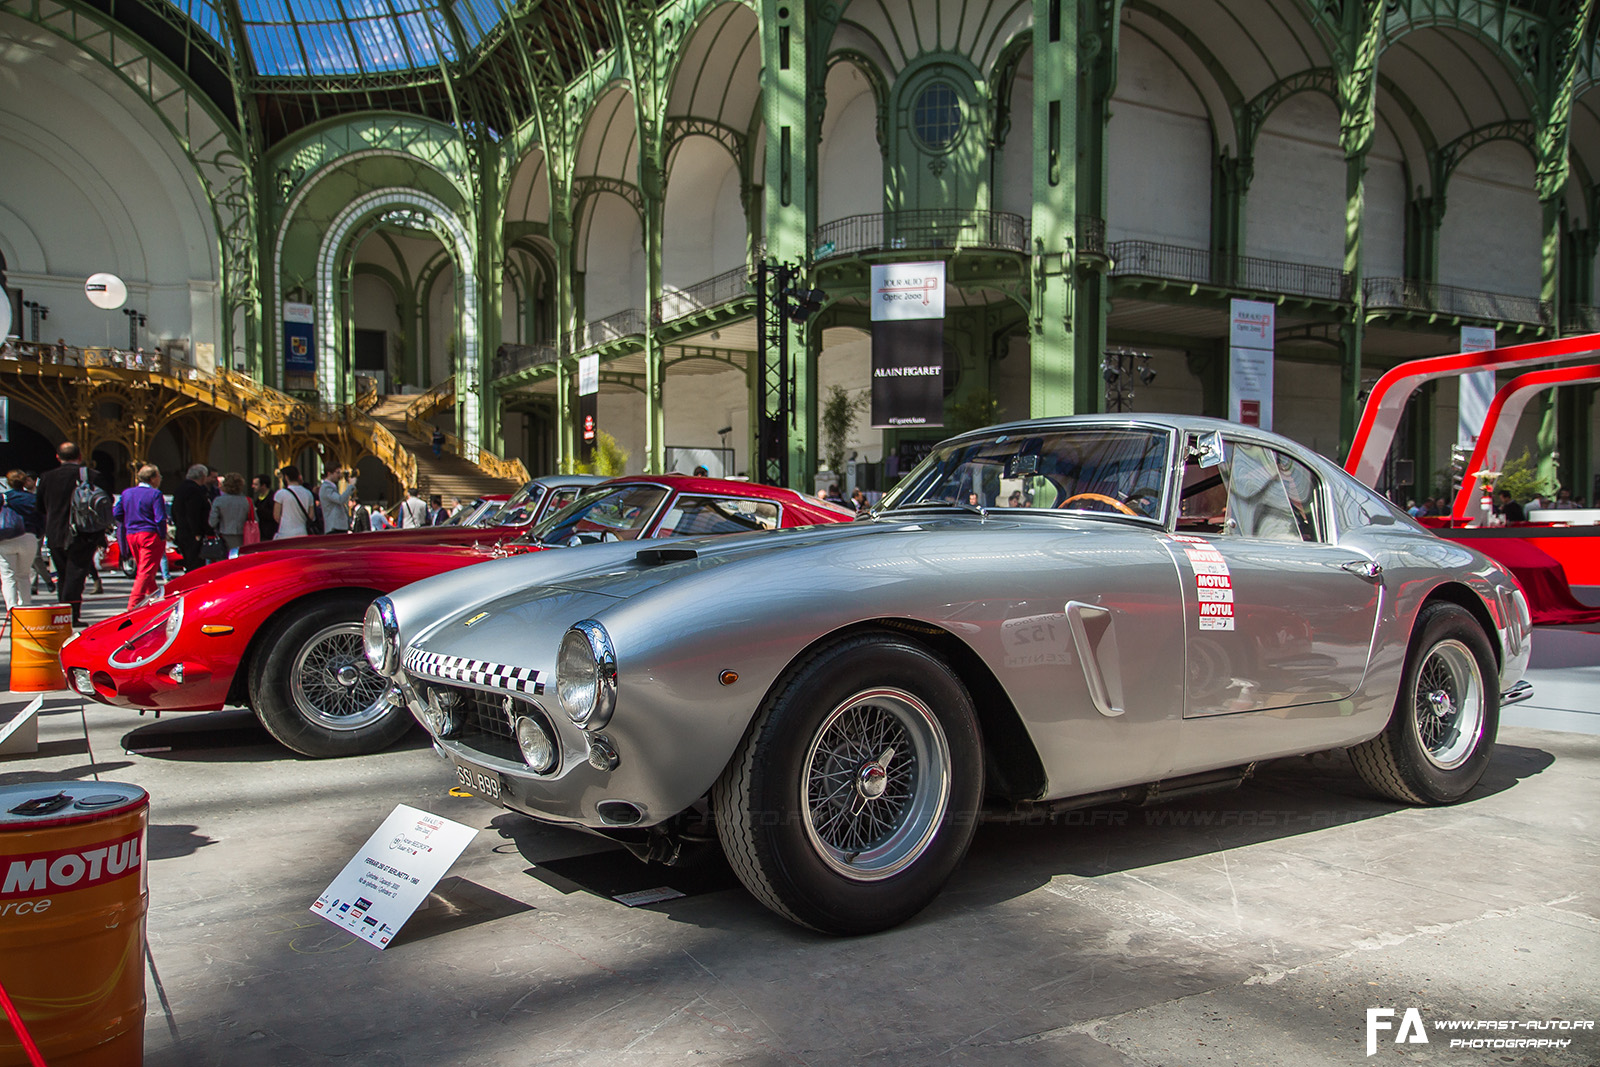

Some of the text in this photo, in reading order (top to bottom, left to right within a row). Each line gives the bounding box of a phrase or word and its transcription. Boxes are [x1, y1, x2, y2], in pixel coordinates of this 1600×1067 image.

[882, 292, 922, 302] Optic 2000
[874, 365, 942, 377] ALAIN FIGARET
[1187, 550, 1225, 562] MOTUL
[1198, 575, 1230, 588] MOTUL
[1200, 603, 1233, 616] MOTUL
[458, 766, 499, 799] SSL 899
[1, 837, 140, 894] MOTUL
[364, 857, 380, 867] FERRARI
[388, 867, 410, 880] BERLINETTA
[0, 898, 52, 916] rce
